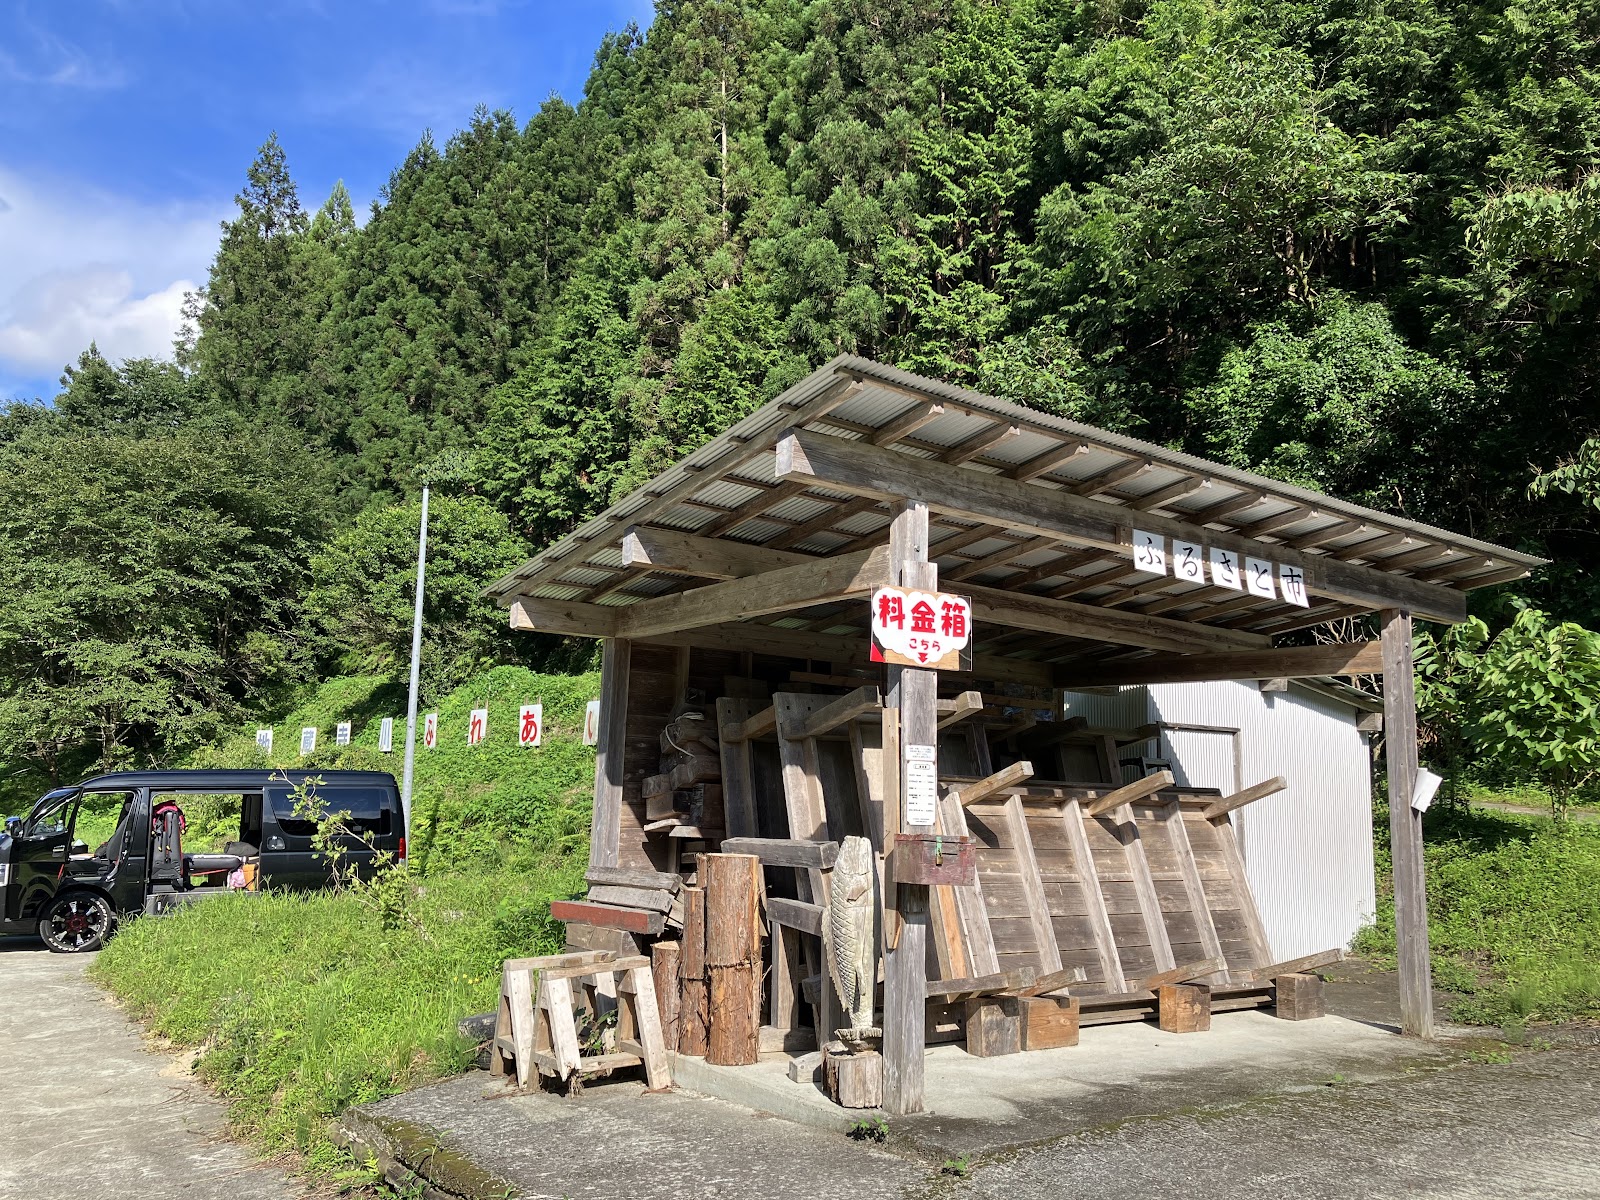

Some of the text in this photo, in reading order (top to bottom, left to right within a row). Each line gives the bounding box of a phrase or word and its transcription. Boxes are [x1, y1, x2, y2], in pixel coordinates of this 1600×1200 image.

[1138, 536, 1302, 603] ふるさと市
[878, 594, 966, 638] 料金箱
[909, 638, 941, 652] こちら
